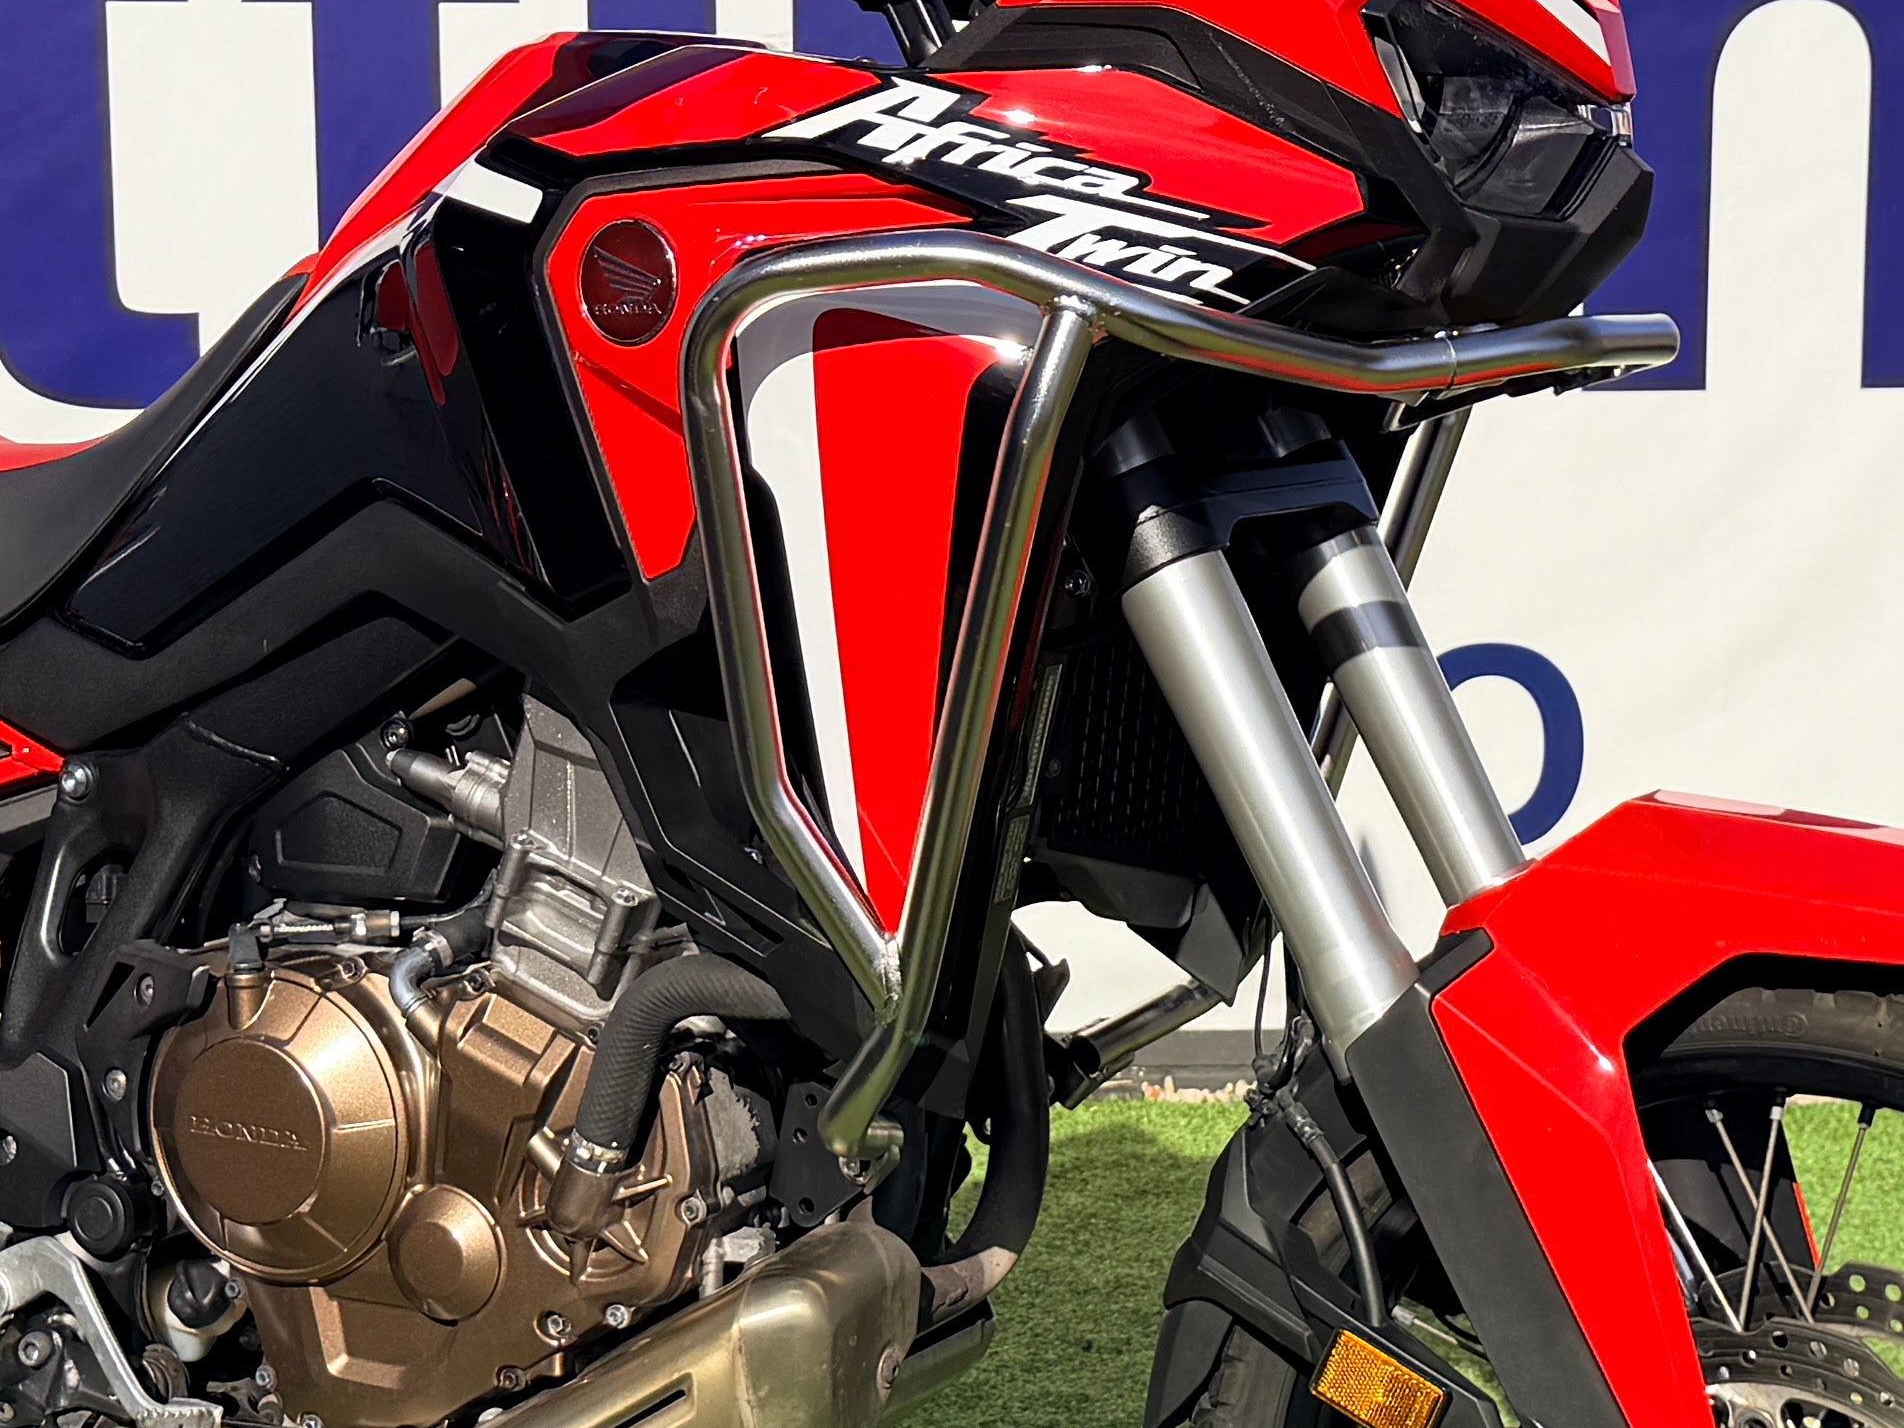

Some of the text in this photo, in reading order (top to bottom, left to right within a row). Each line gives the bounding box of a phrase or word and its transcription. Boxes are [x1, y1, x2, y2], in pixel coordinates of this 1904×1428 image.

[761, 76, 1211, 220] Africa
[1003, 193, 1318, 305] Twin
[190, 1115, 309, 1152] HONDA
